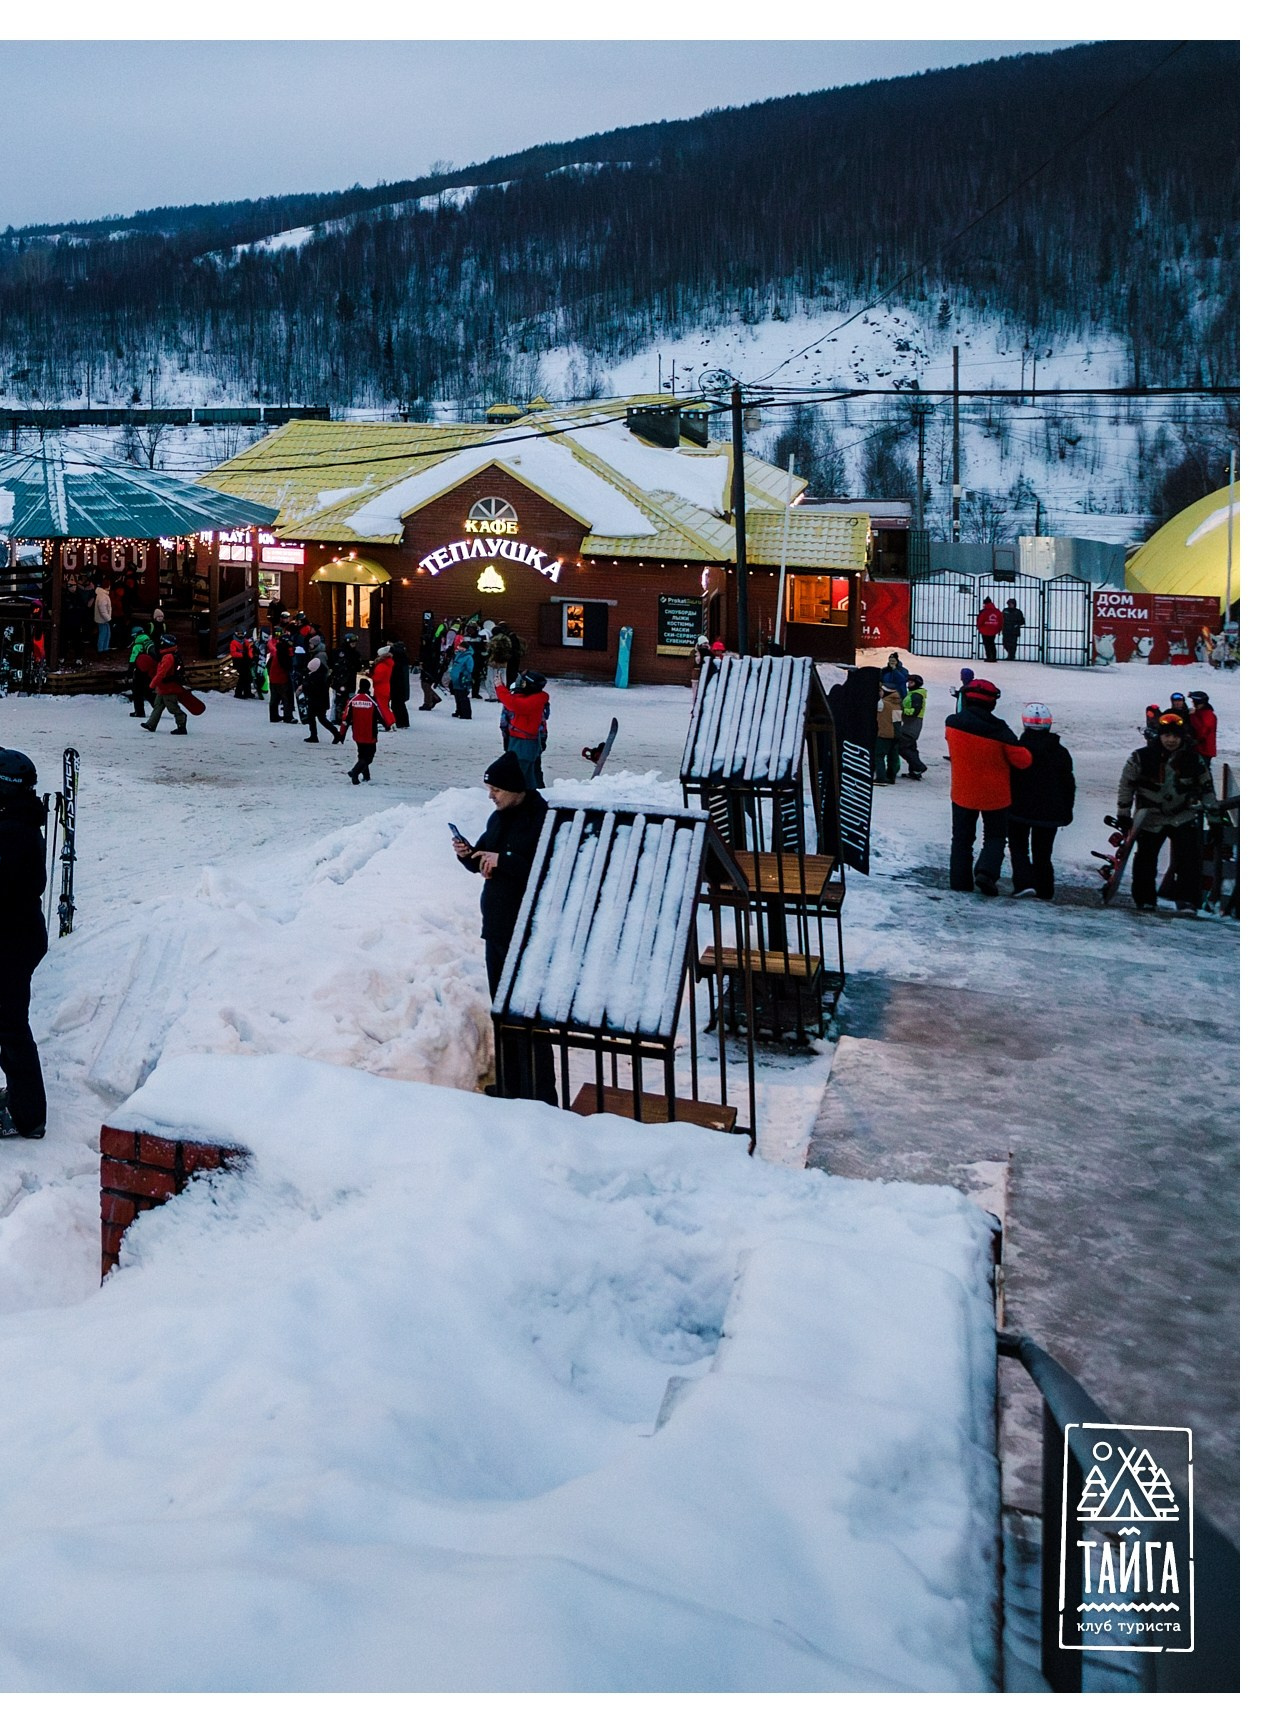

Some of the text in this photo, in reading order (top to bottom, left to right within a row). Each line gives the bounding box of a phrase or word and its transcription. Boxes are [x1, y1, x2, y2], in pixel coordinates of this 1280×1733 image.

[466, 520, 518, 535] КАФЕ
[419, 538, 562, 583] ТЕПЛУШКА
[1097, 594, 1134, 606] ДОМ
[1097, 607, 1148, 619] ХАСКИ
[65, 752, 75, 832] FISCHER
